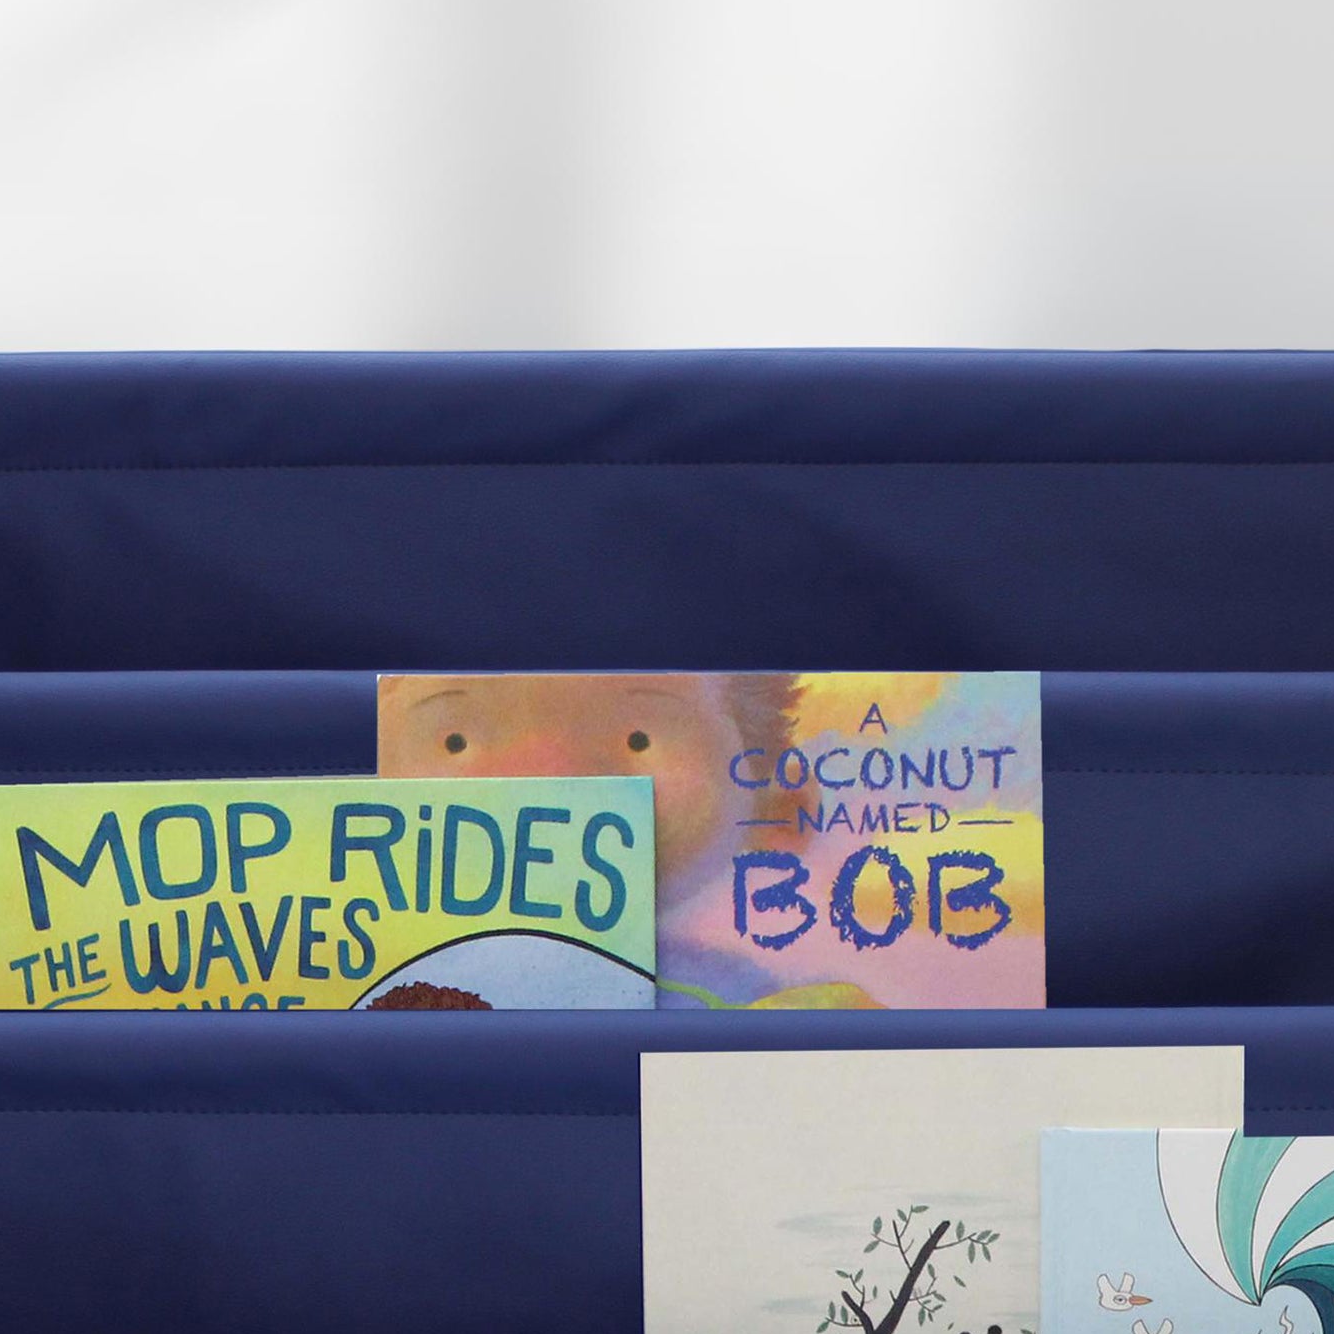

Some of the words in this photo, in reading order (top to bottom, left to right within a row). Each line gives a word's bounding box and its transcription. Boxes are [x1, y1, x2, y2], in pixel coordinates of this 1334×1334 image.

[859, 703, 888, 734] A
[729, 745, 1017, 792] COCONUT
[798, 802, 951, 835] NAMED
[16, 802, 292, 930] MOP
[732, 845, 1013, 951] BOB
[9, 933, 106, 1005] THE
[118, 895, 381, 994] WAVES
